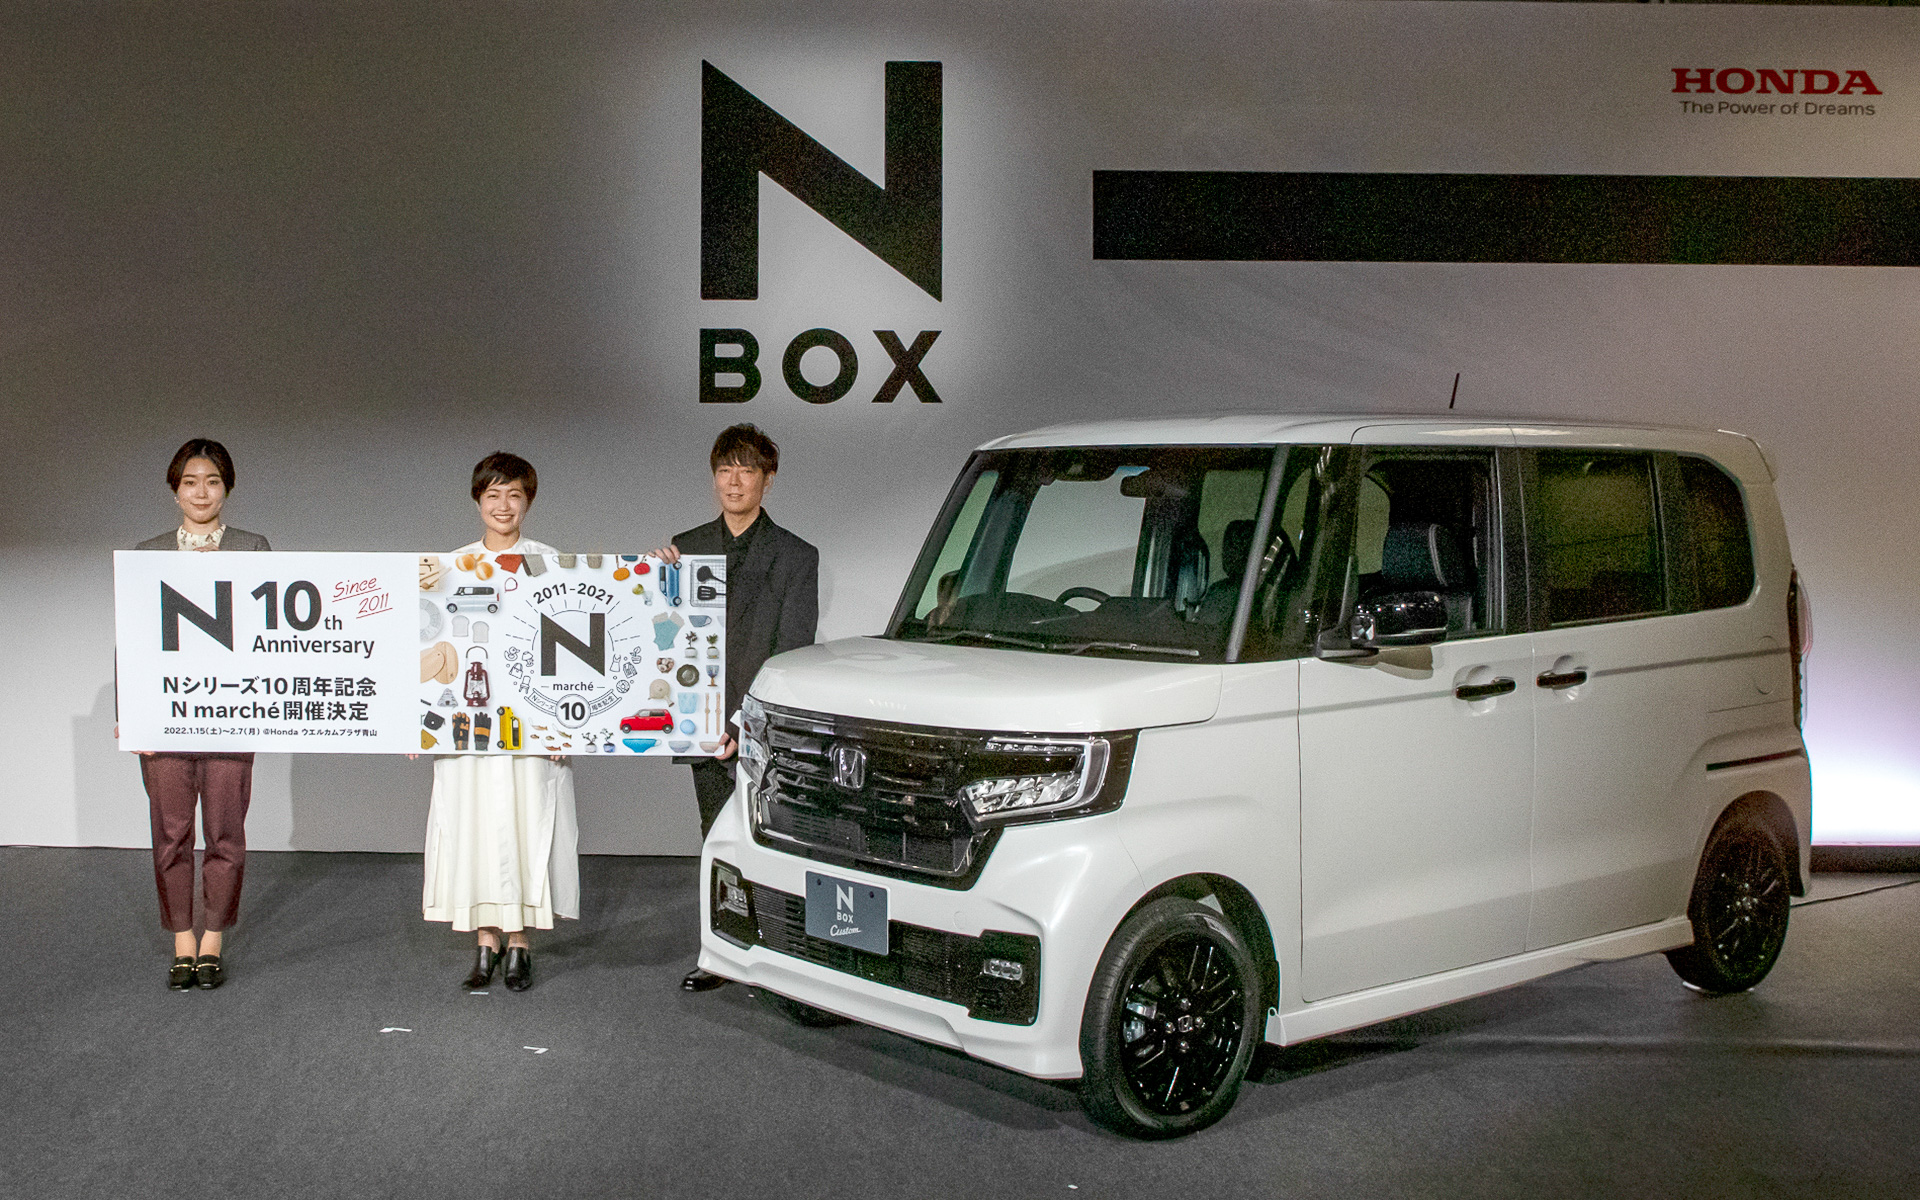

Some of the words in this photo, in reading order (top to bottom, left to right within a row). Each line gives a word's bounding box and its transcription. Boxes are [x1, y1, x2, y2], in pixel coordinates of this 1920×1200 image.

[1671, 68, 1883, 95] HONDA
[1679, 100, 1714, 114] The
[1718, 101, 1775, 115] Power
[1780, 101, 1800, 115] of
[1805, 102, 1876, 116] Dreams
[701, 59, 943, 303] N
[699, 327, 943, 404] BOX
[332, 577, 378, 599] Since
[160, 579, 234, 652] N
[358, 593, 390, 615] 2011
[252, 635, 375, 659] Anniversary
[540, 612, 606, 677] N
[552, 681, 594, 691] marché
[560, 702, 586, 721] 10
[836, 883, 854, 913] N
[836, 911, 854, 924] BOX
[829, 924, 862, 937] Custom
